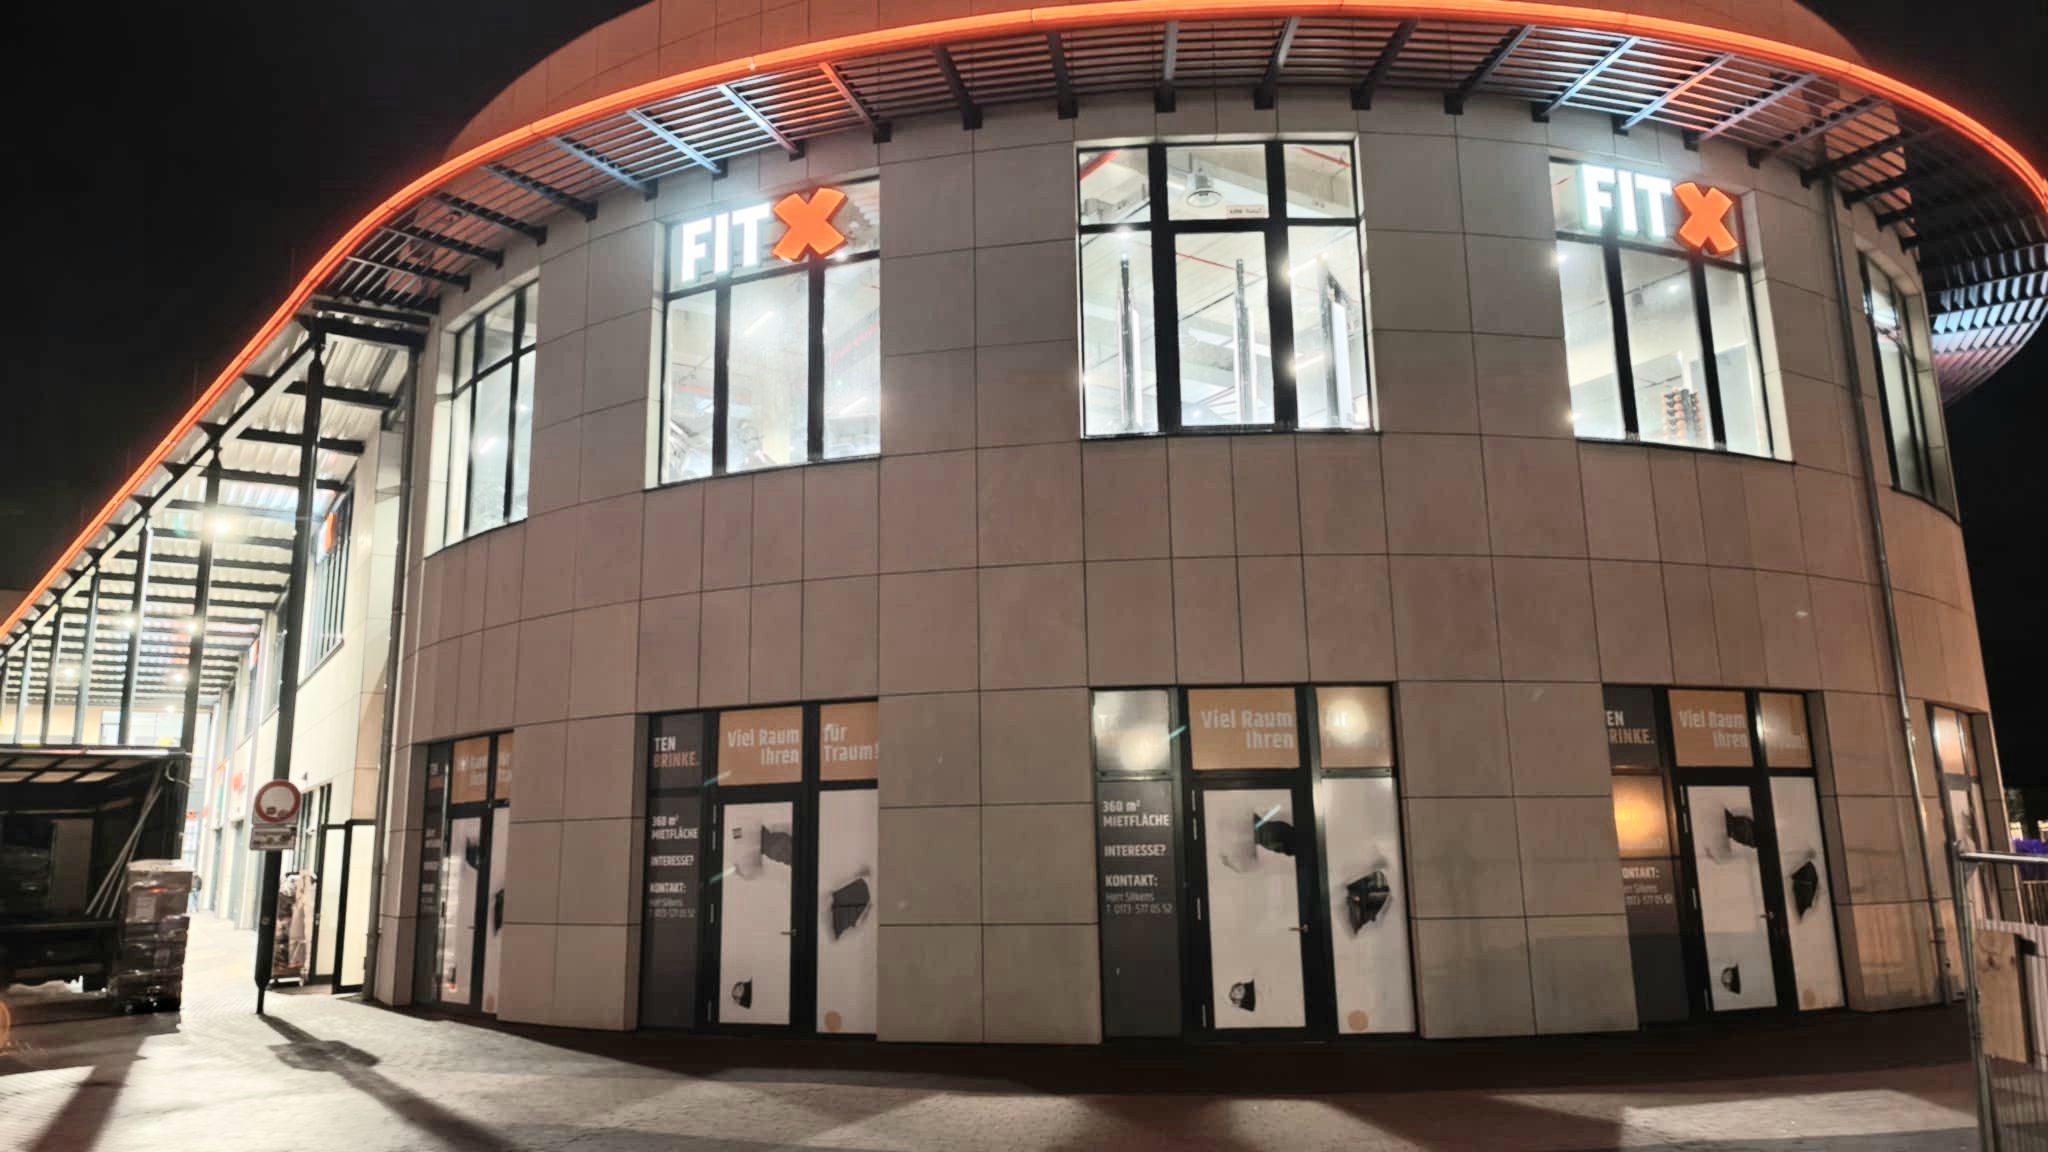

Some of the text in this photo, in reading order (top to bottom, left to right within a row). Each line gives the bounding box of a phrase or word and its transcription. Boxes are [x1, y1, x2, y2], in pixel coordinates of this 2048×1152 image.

[1200, 708, 1294, 729] Viel Raum
[1606, 710, 1625, 727] EN
[1678, 709, 1705, 729] Viel
[1707, 710, 1745, 729] Raum
[654, 735, 677, 752] TEN
[727, 722, 848, 748] Viel Raum für
[1245, 730, 1295, 750] Ihren
[1608, 728, 1655, 745] RINKE.
[760, 742, 880, 766] Ihren Traum!
[1103, 843, 1167, 857] INTERESSE?
[1104, 873, 1159, 888] KONTAKT:
